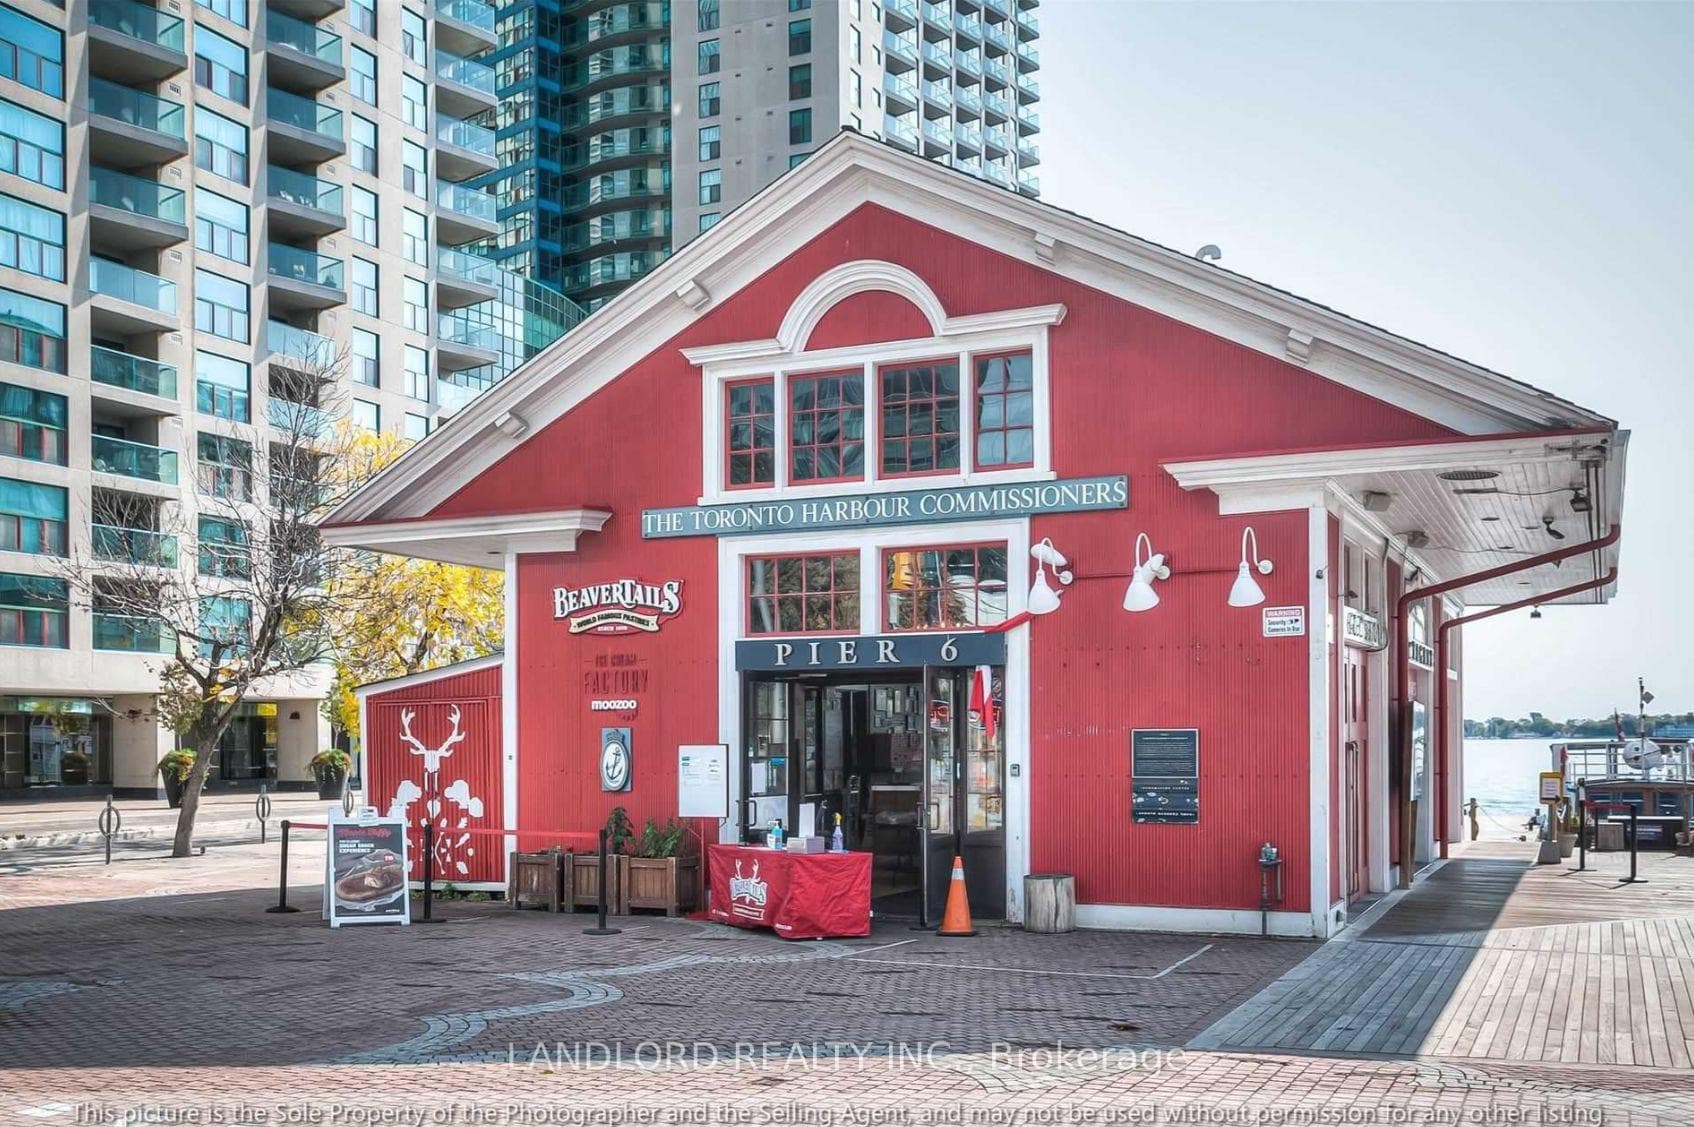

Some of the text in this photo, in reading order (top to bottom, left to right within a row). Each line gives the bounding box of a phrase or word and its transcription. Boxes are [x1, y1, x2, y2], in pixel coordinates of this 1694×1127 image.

[643, 481, 1126, 533] THE TORONTO HARBOUR COMMISSIONERS
[775, 637, 959, 666] PIER 6
[584, 669, 648, 695] FACTORY
[591, 700, 637, 710] moozoo
